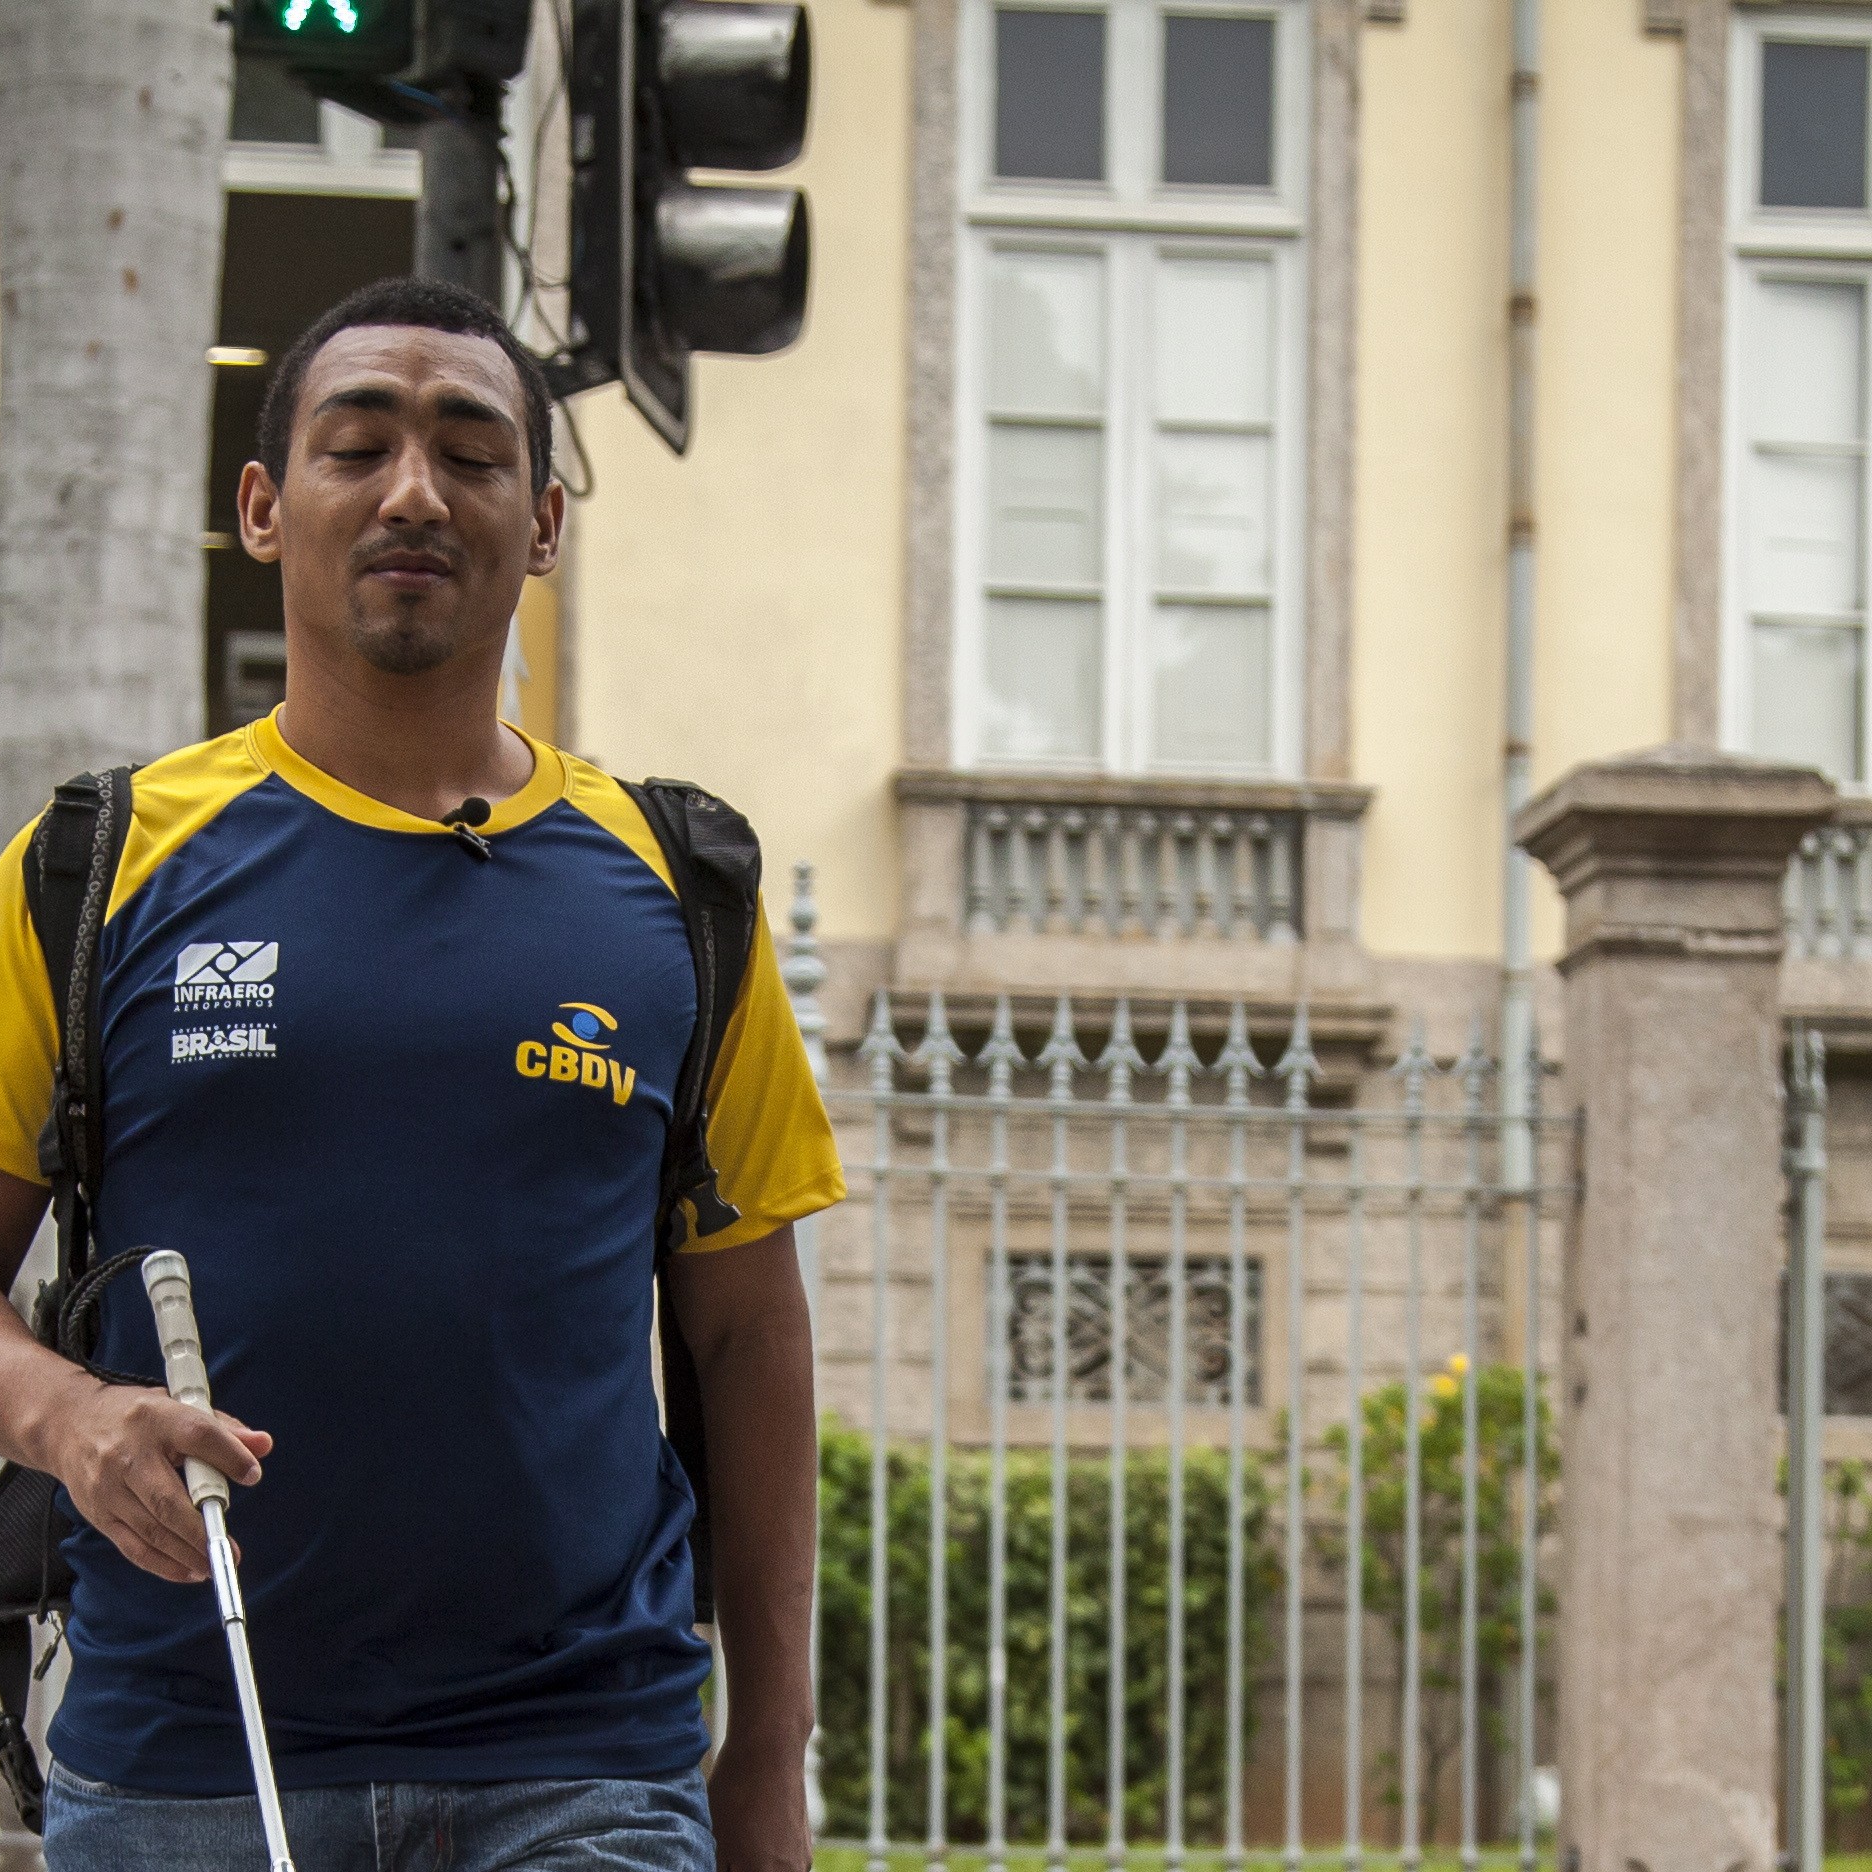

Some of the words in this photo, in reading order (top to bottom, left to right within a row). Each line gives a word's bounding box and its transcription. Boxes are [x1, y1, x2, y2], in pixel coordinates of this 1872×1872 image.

[174, 984, 274, 1003] INFRAERO
[174, 999, 273, 1012] AEROPORTOS
[172, 1028, 276, 1058] BRASIL
[515, 1040, 636, 1106] CBDV
